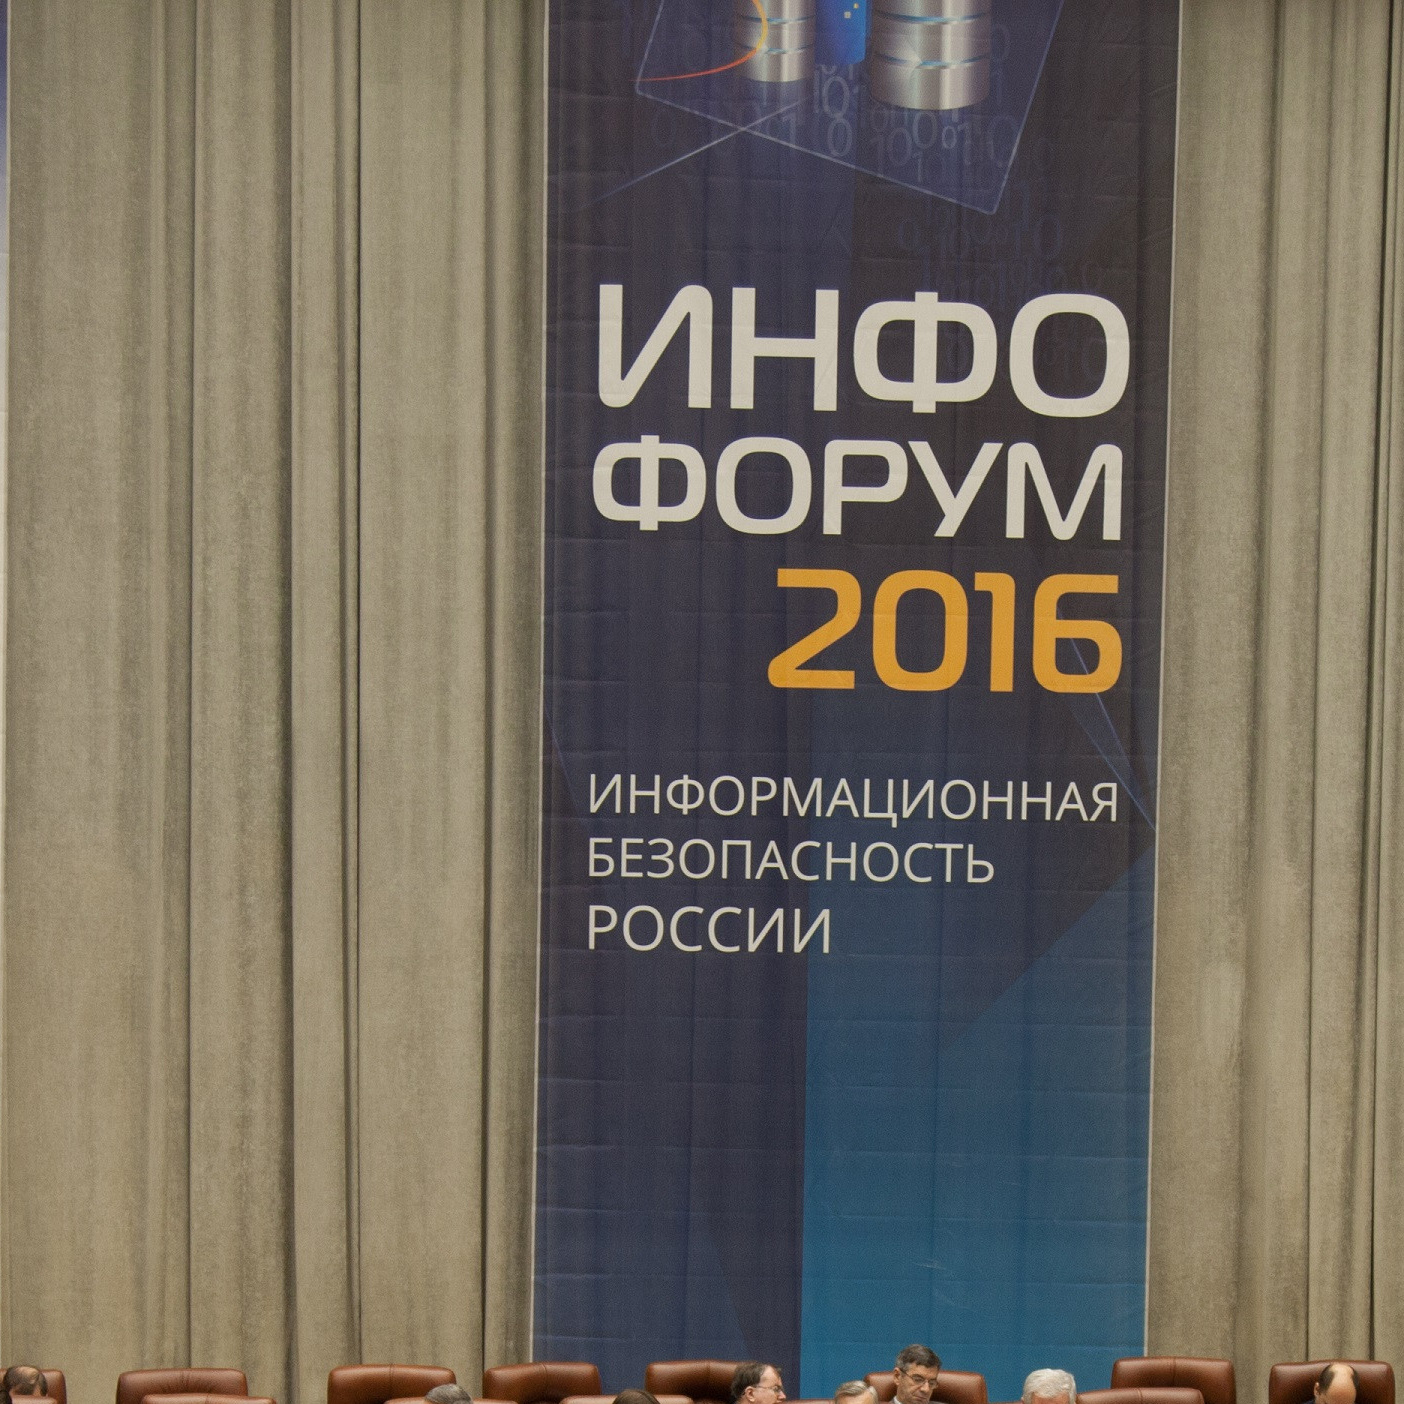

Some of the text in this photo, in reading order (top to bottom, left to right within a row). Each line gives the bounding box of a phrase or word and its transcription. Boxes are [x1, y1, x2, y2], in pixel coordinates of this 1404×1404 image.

[598, 283, 1130, 418] ИНФО
[592, 434, 1123, 540] ФОРУМ
[767, 568, 1123, 693] 2016
[588, 773, 1118, 828] ИНФОРМАЦИОННАЯ
[588, 837, 995, 883] БЕЗОПАСНОСТЬ
[587, 904, 832, 954] РОССИИ
